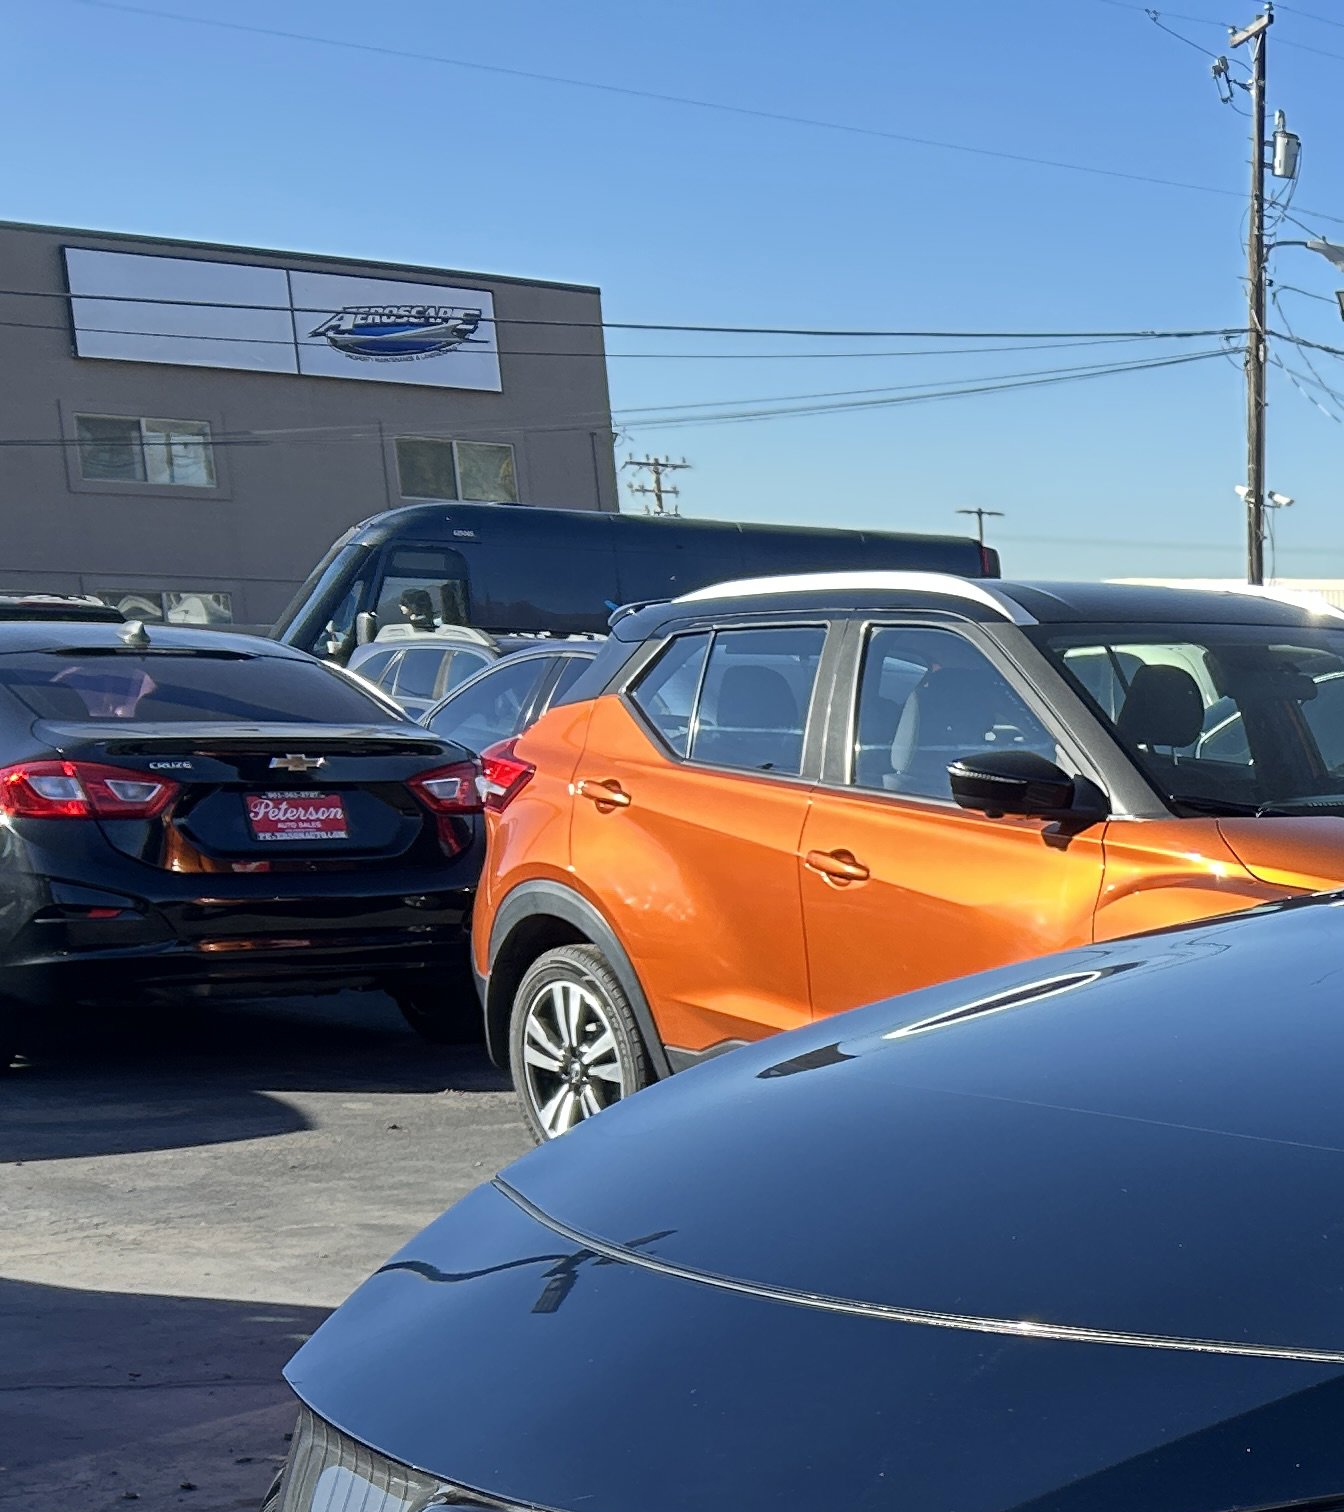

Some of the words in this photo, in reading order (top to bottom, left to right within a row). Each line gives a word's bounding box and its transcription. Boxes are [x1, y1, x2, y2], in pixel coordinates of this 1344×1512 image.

[308, 305, 482, 338] AEROSCAPE
[149, 761, 192, 770] CRUZE
[249, 799, 345, 821] Peterson
[277, 821, 298, 829] AUTO
[298, 821, 322, 829] SALES
